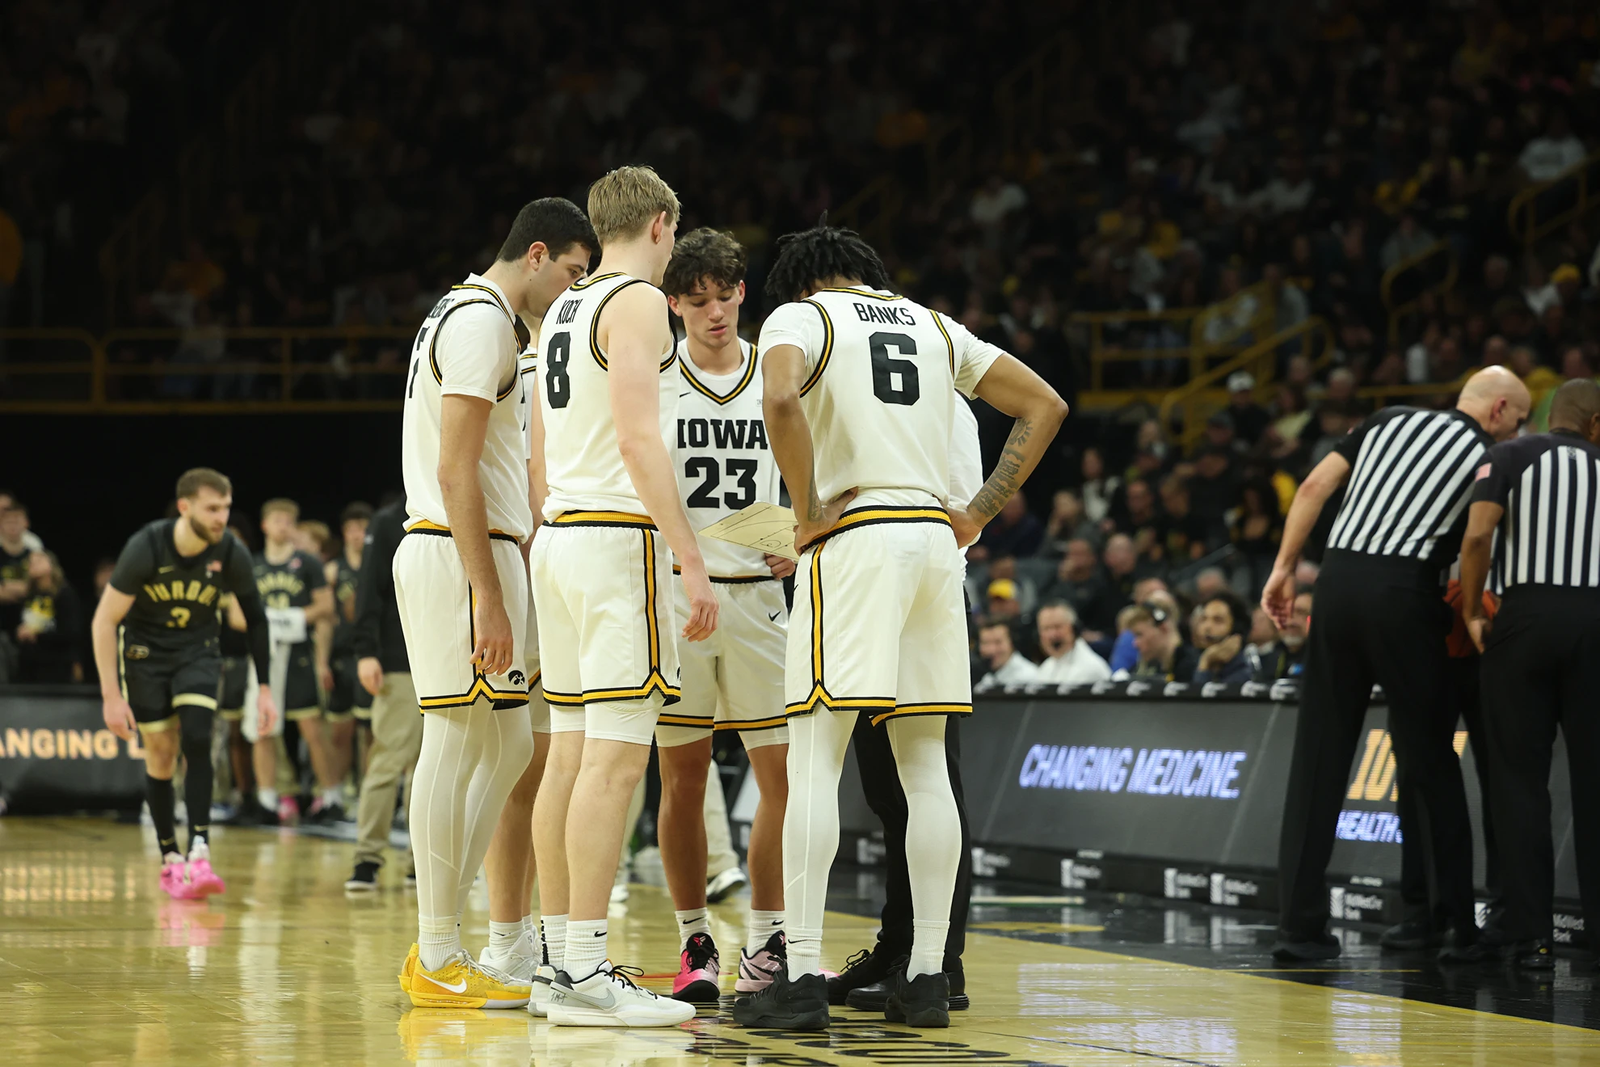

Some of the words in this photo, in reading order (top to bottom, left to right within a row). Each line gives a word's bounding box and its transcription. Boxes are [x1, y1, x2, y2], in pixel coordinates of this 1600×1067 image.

[556, 298, 583, 325] KOCH
[853, 302, 916, 326] BANKS
[546, 331, 571, 409] 8
[869, 331, 921, 407] 6
[677, 418, 769, 450] IOWA
[684, 456, 758, 510] 23
[1018, 743, 1134, 793] CHANGING
[1126, 748, 1247, 798] MEDICINE.
[1335, 809, 1400, 843] HEALTH
